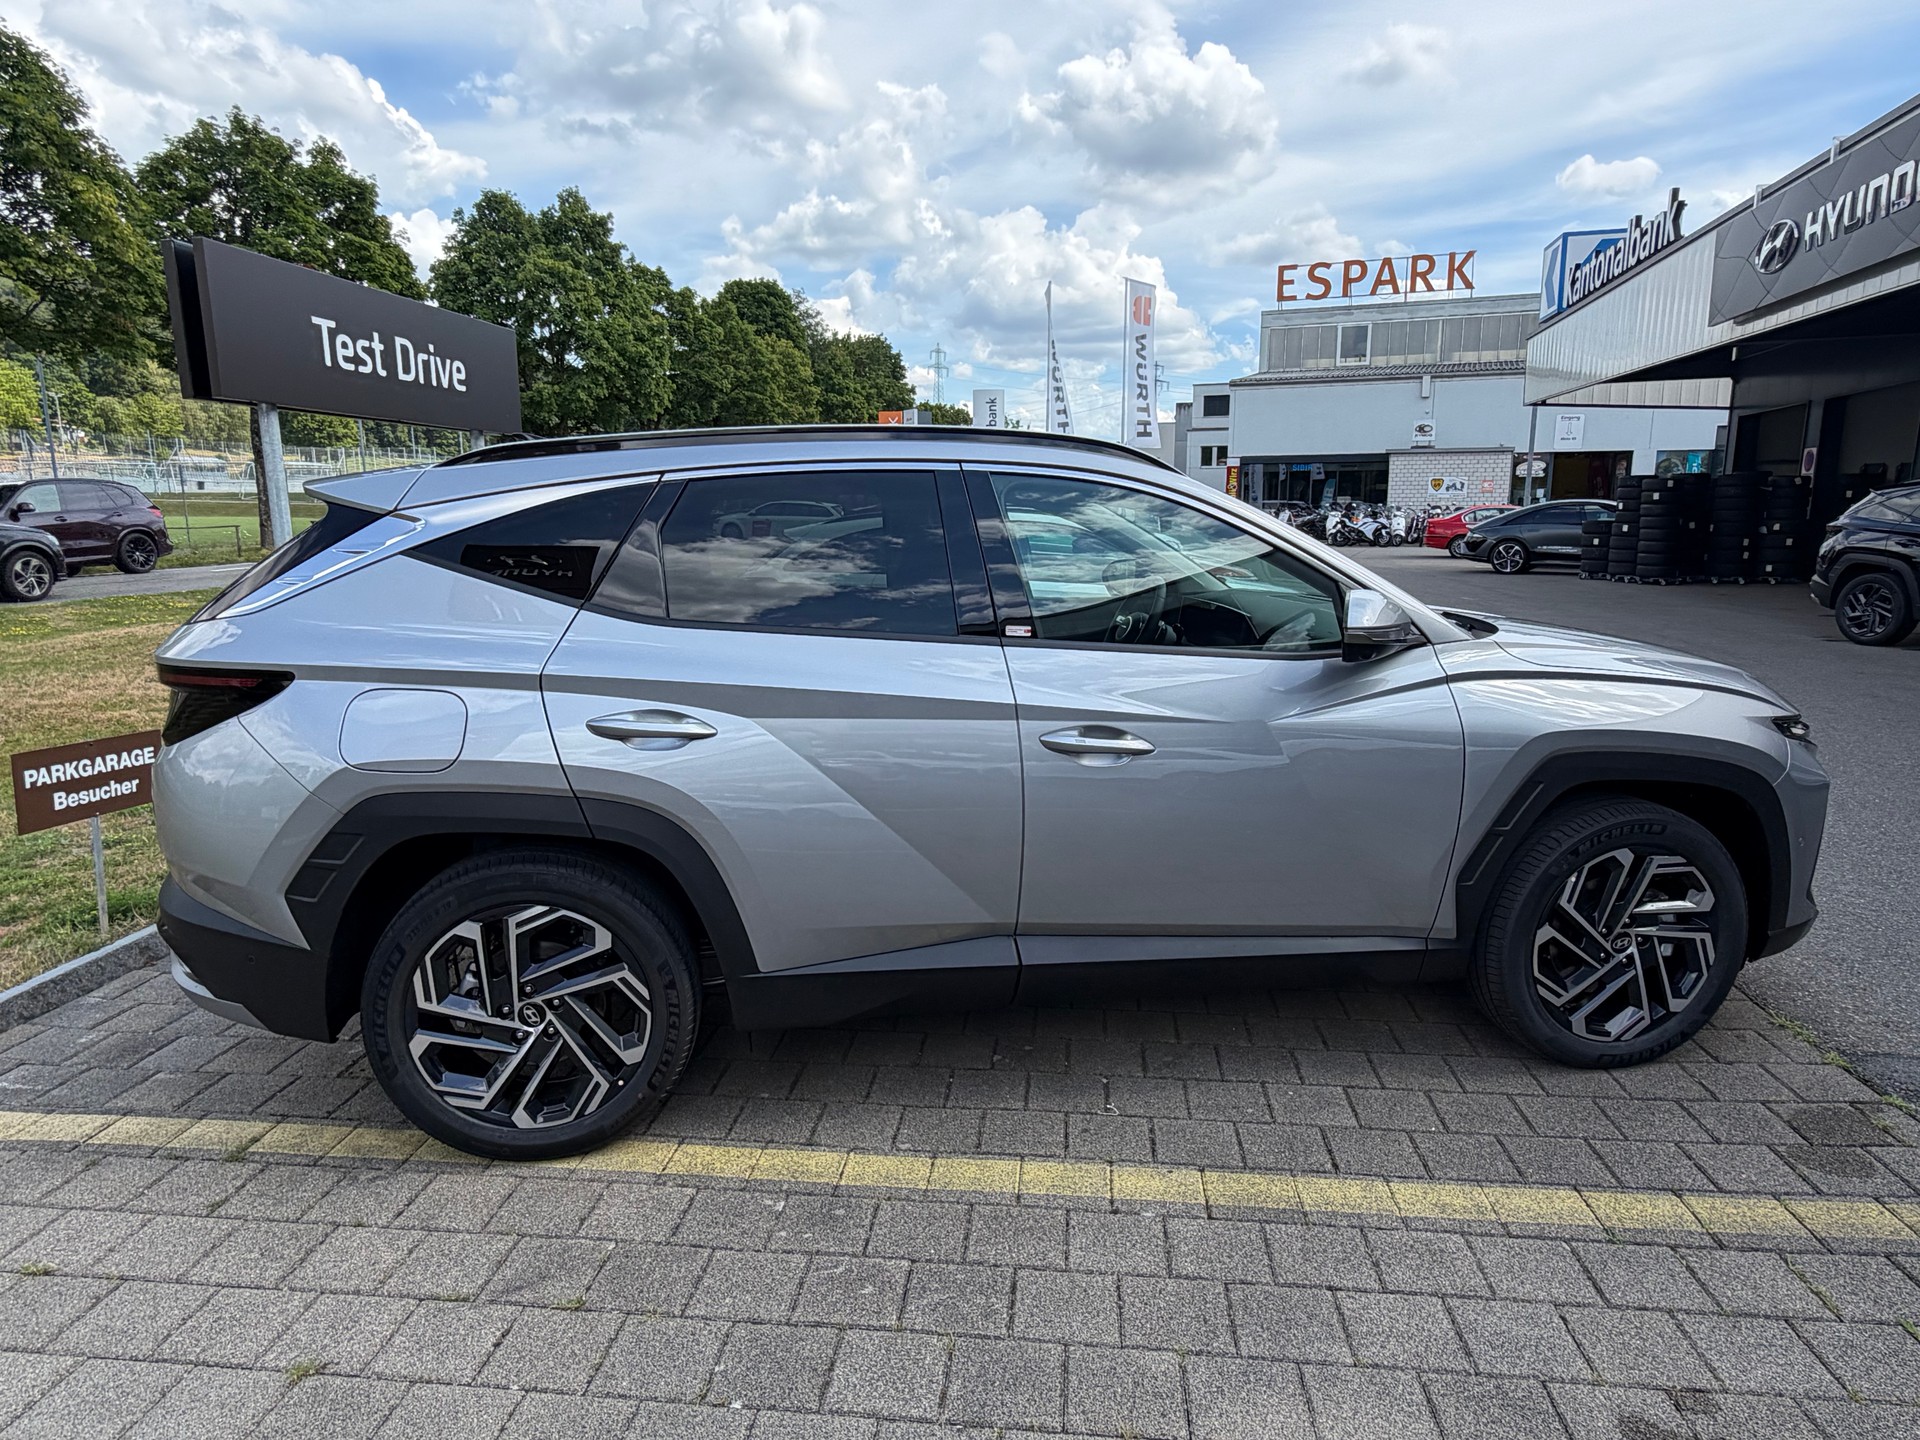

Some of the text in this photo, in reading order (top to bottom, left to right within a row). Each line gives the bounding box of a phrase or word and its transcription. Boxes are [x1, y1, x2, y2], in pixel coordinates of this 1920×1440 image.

[1804, 159, 1920, 253] HYUND
[1277, 250, 1477, 302] ESPARK
[1562, 187, 1686, 308] Kantonalbank
[311, 316, 467, 392] Test Drive
[1135, 333, 1152, 438] WÜRTH
[985, 397, 998, 427] bank
[23, 746, 155, 789] PARKGARAGE
[53, 779, 140, 811] Besucher
[1578, 823, 1664, 855] MICHELIN
[372, 949, 403, 1053] MICHELIN
[651, 988, 680, 1087] MICHELIN
